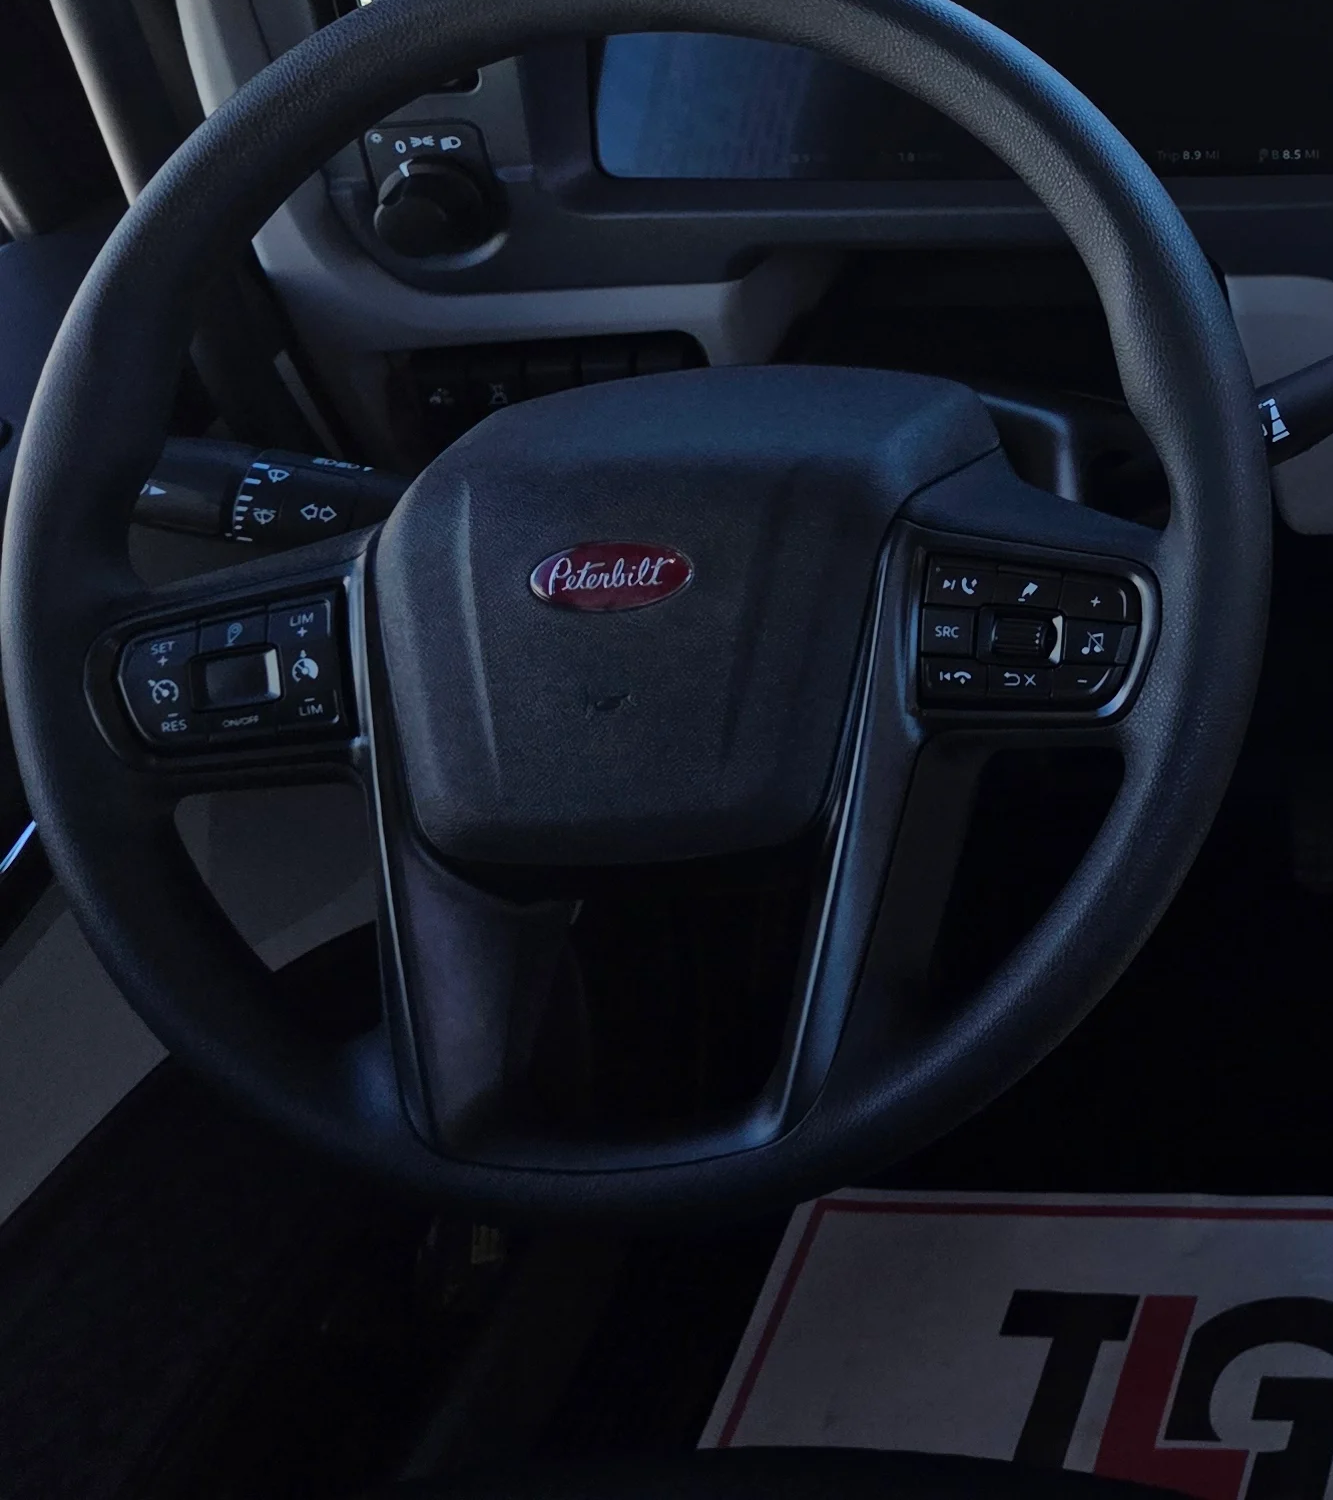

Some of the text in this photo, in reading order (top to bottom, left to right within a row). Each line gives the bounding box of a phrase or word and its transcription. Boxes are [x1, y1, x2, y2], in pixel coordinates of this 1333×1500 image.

[1157, 150, 1179, 163] Trip
[1182, 150, 1201, 160] 8.9
[1282, 149, 1301, 160] 8.5
[549, 557, 676, 596] Peterbilt
[289, 612, 314, 627] LIM
[934, 625, 960, 639] SRC
[151, 641, 176, 655] SET
[299, 704, 324, 717] LIM
[161, 719, 187, 733] RES
[222, 714, 260, 729] ON/OFF
